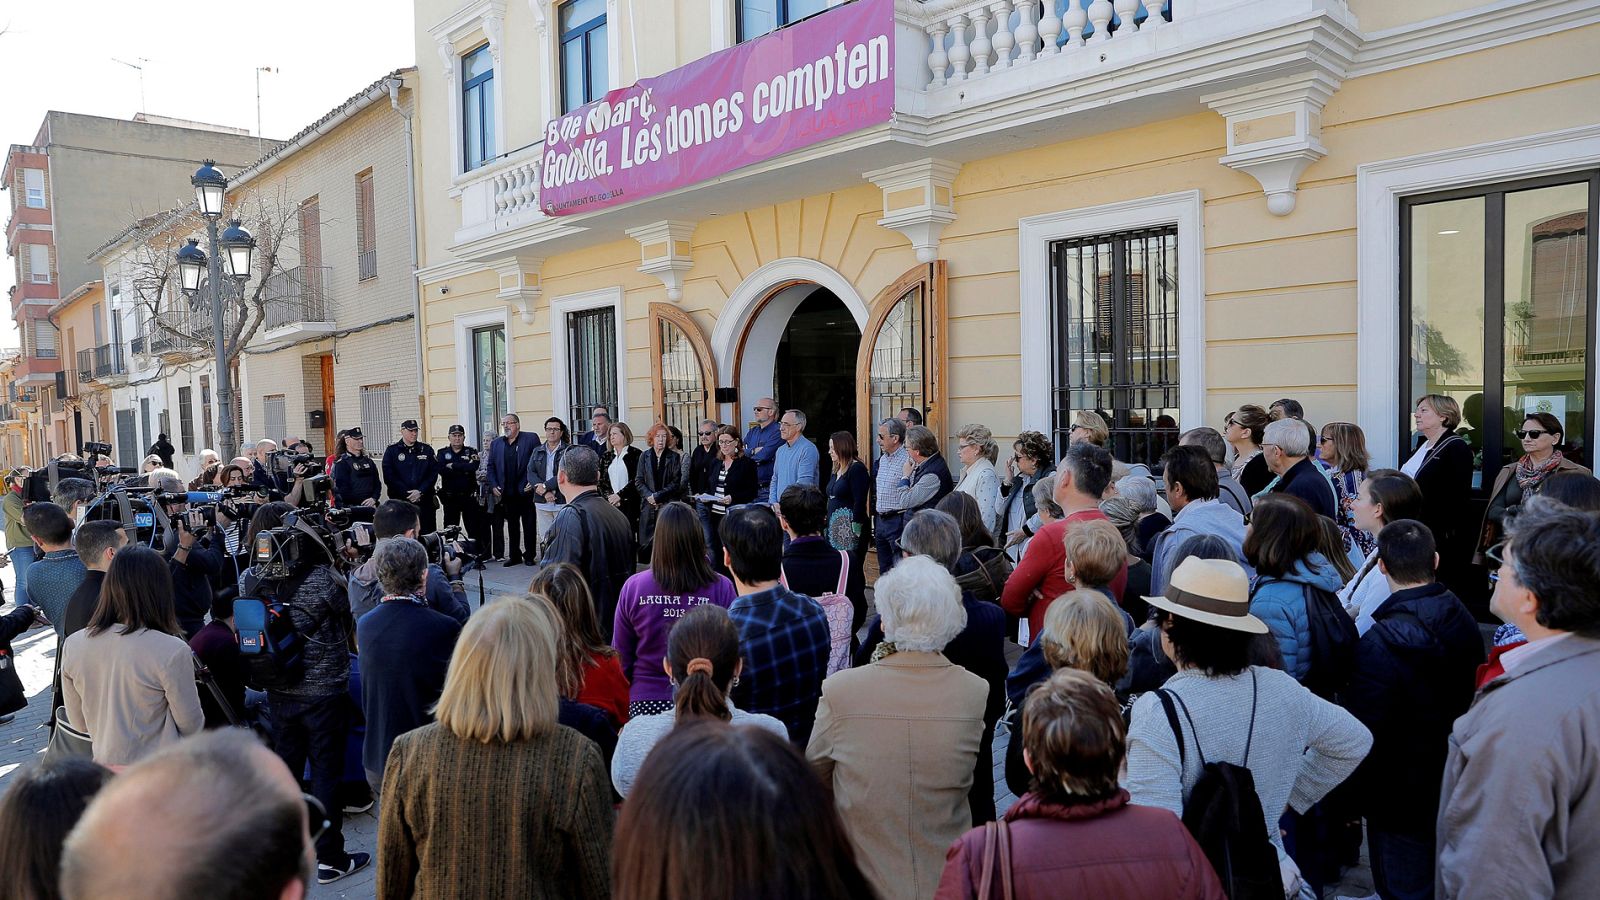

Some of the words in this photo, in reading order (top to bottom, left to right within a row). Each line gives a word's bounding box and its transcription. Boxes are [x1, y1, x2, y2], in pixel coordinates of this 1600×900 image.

[620, 123, 662, 169] Les
[665, 91, 744, 154] dones
[752, 34, 889, 124] compten
[547, 120, 559, 146] 8
[207, 492, 218, 500] tve
[135, 514, 153, 526] tve
[639, 595, 681, 606] LAURA
[663, 608, 686, 618] 2013
